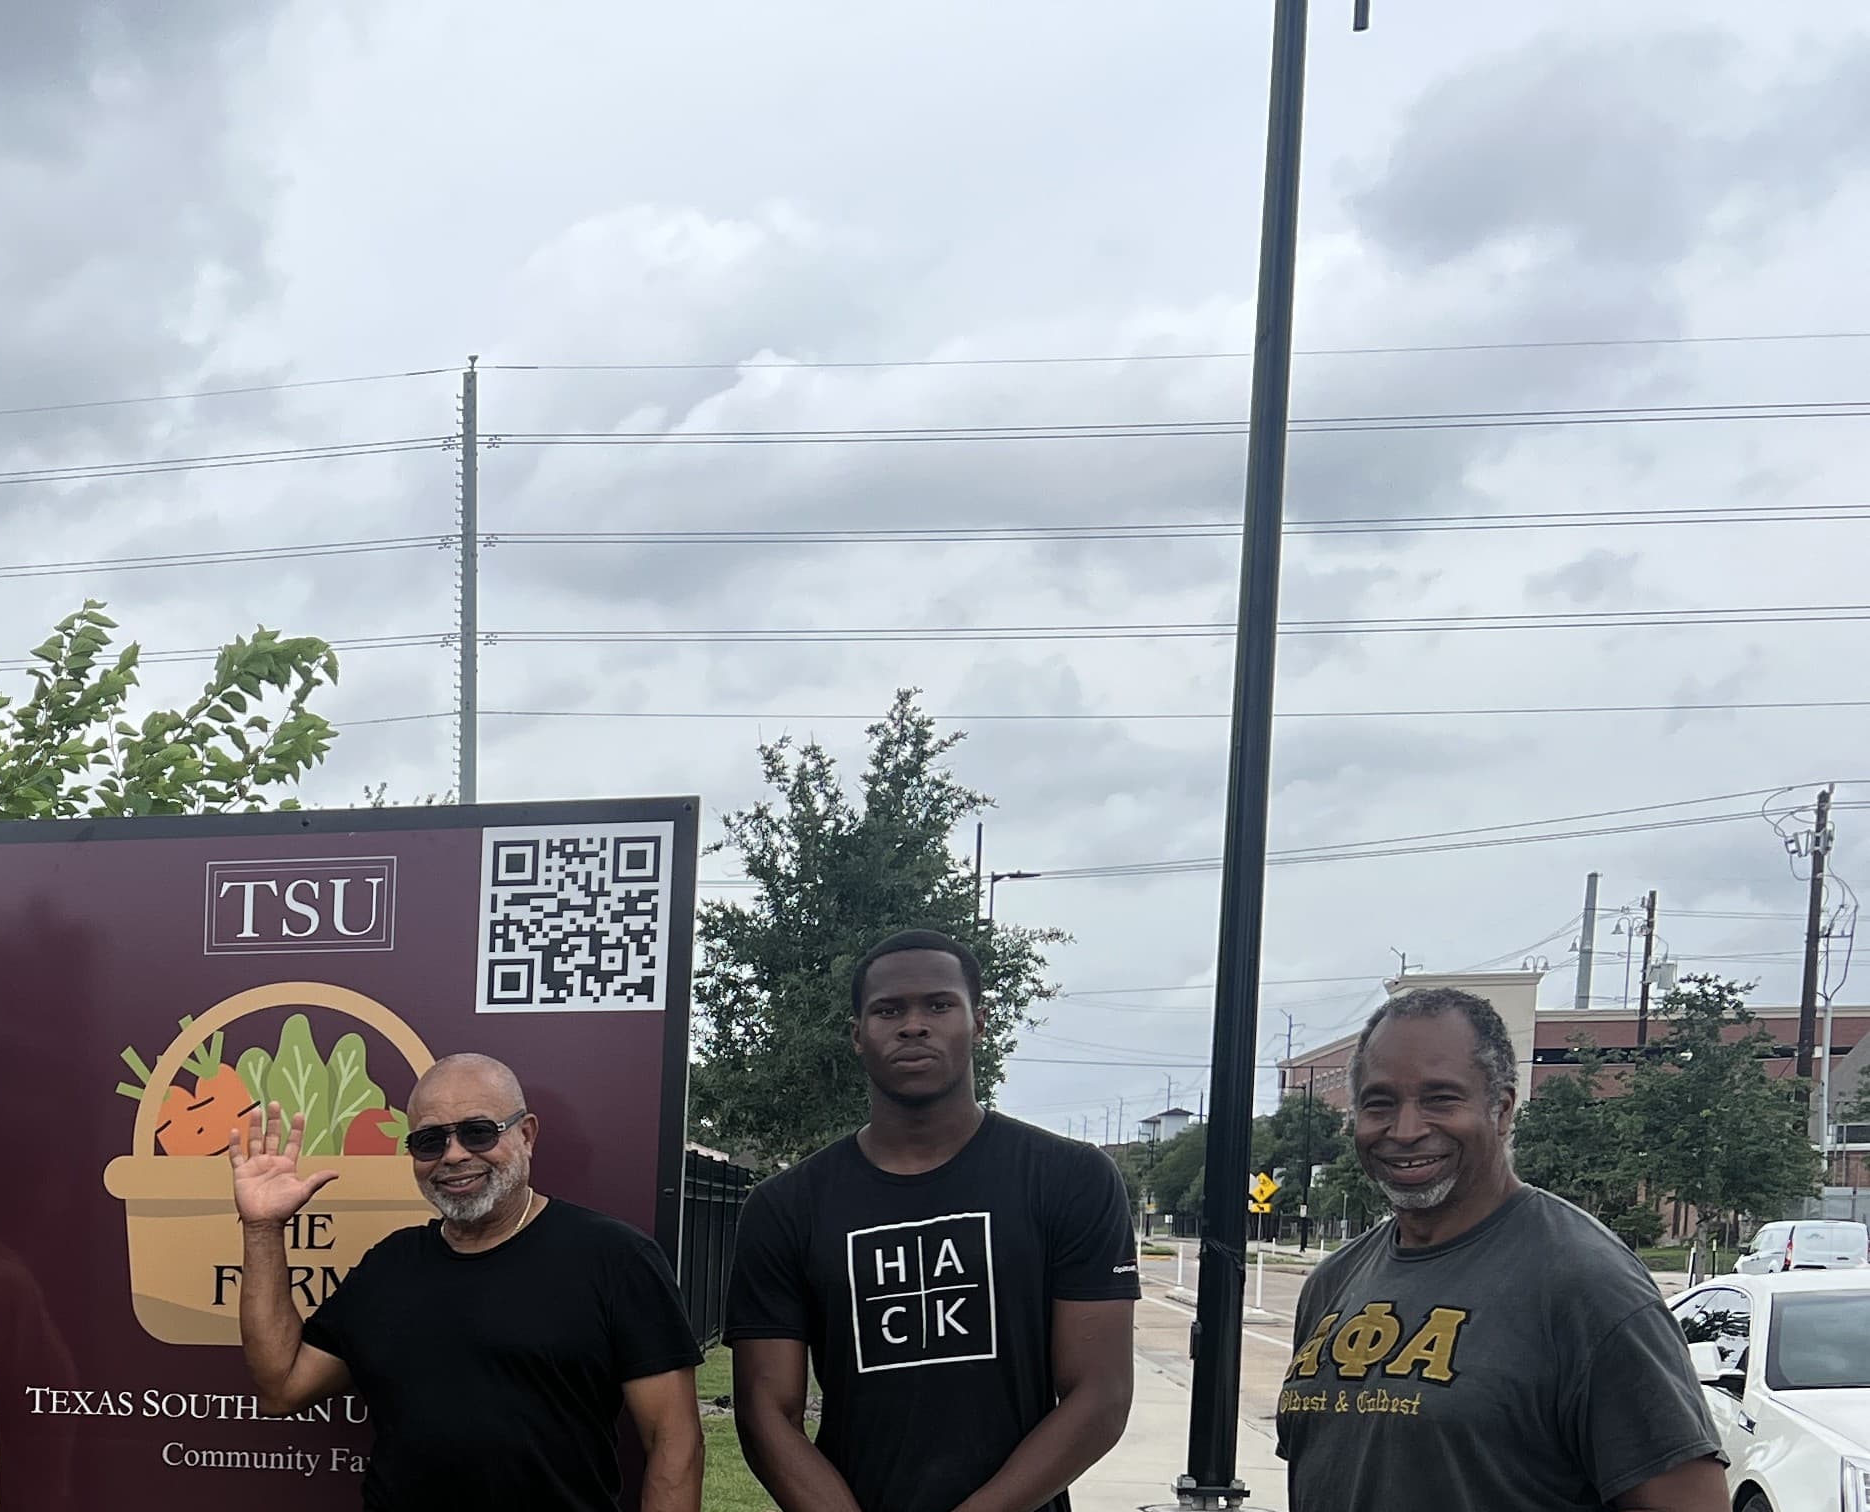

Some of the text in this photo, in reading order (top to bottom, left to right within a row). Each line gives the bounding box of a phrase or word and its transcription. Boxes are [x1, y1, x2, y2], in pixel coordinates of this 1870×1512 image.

[219, 878, 383, 938] TSU
[211, 1265, 358, 1307] FR
[25, 1386, 134, 1416] TEXAS
[142, 1389, 333, 1423] SOUTHN
[1334, 1390, 1350, 1413] &
[161, 1442, 371, 1477] Community Fa
